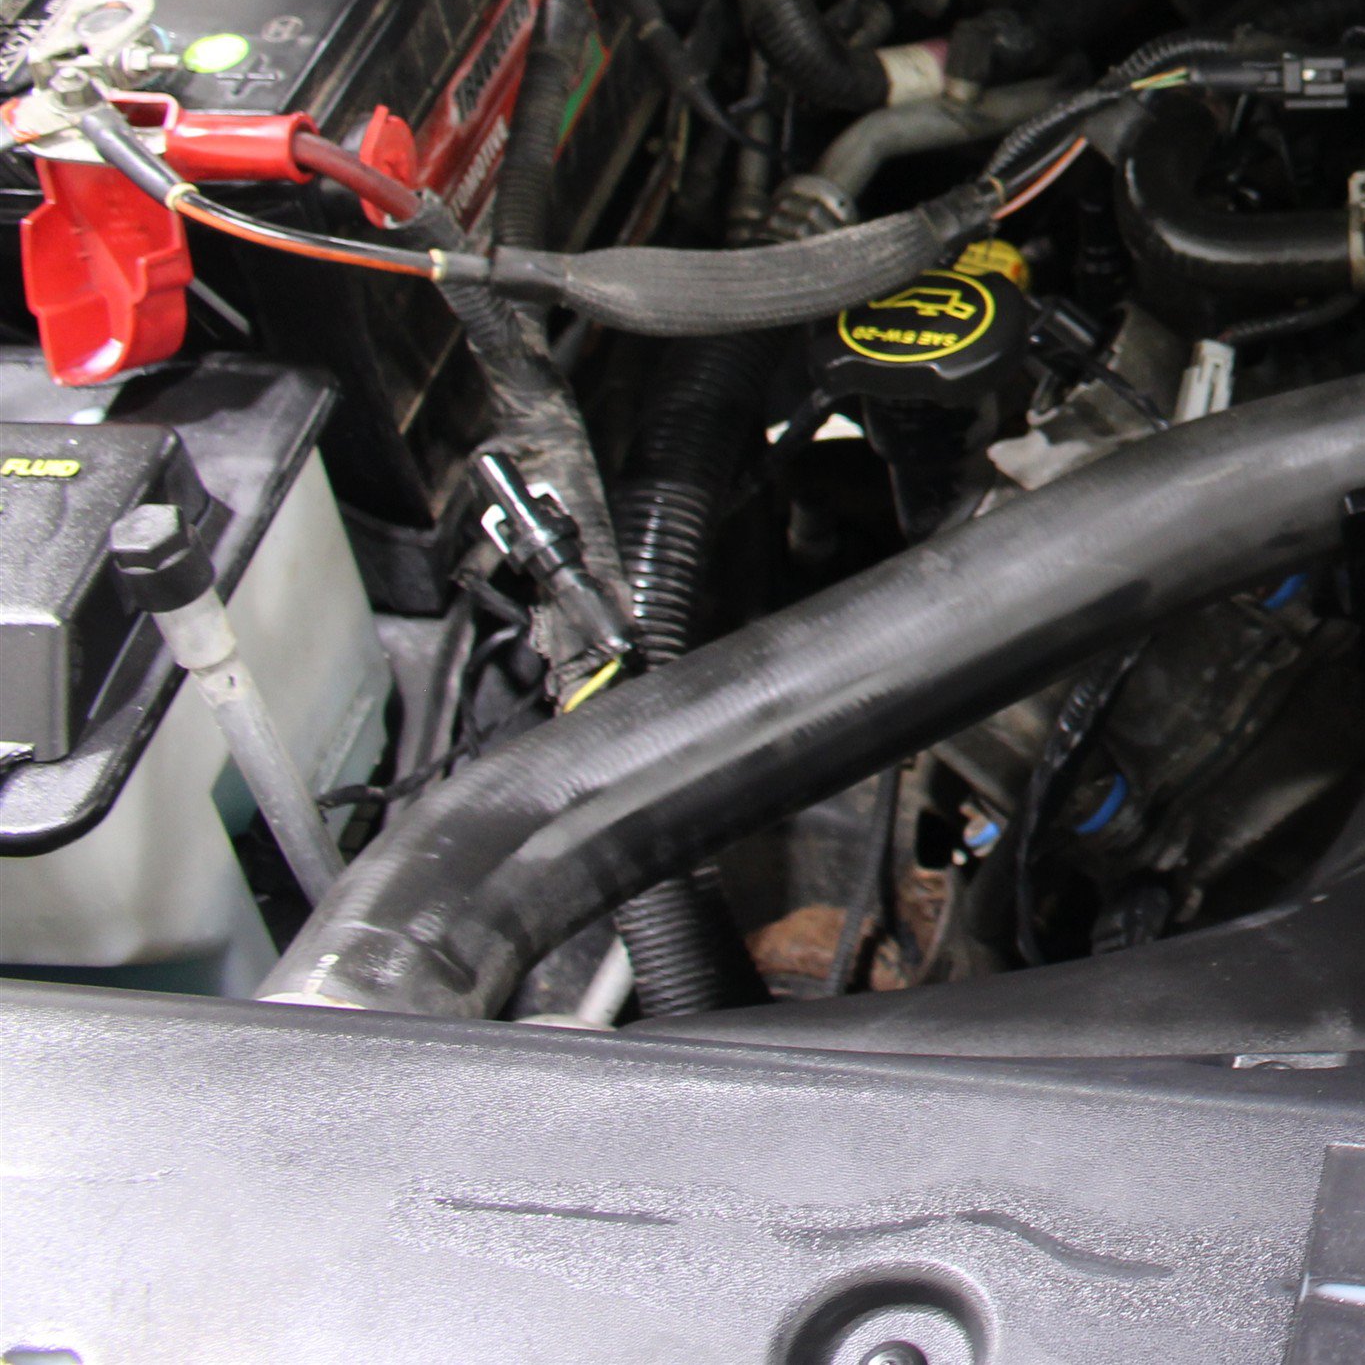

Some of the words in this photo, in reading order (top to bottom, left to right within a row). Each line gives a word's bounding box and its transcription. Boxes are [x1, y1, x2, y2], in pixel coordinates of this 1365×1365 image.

[851, 326, 918, 345] 5W-20
[917, 329, 960, 348] SAE
[0, 457, 82, 478] FLUID
